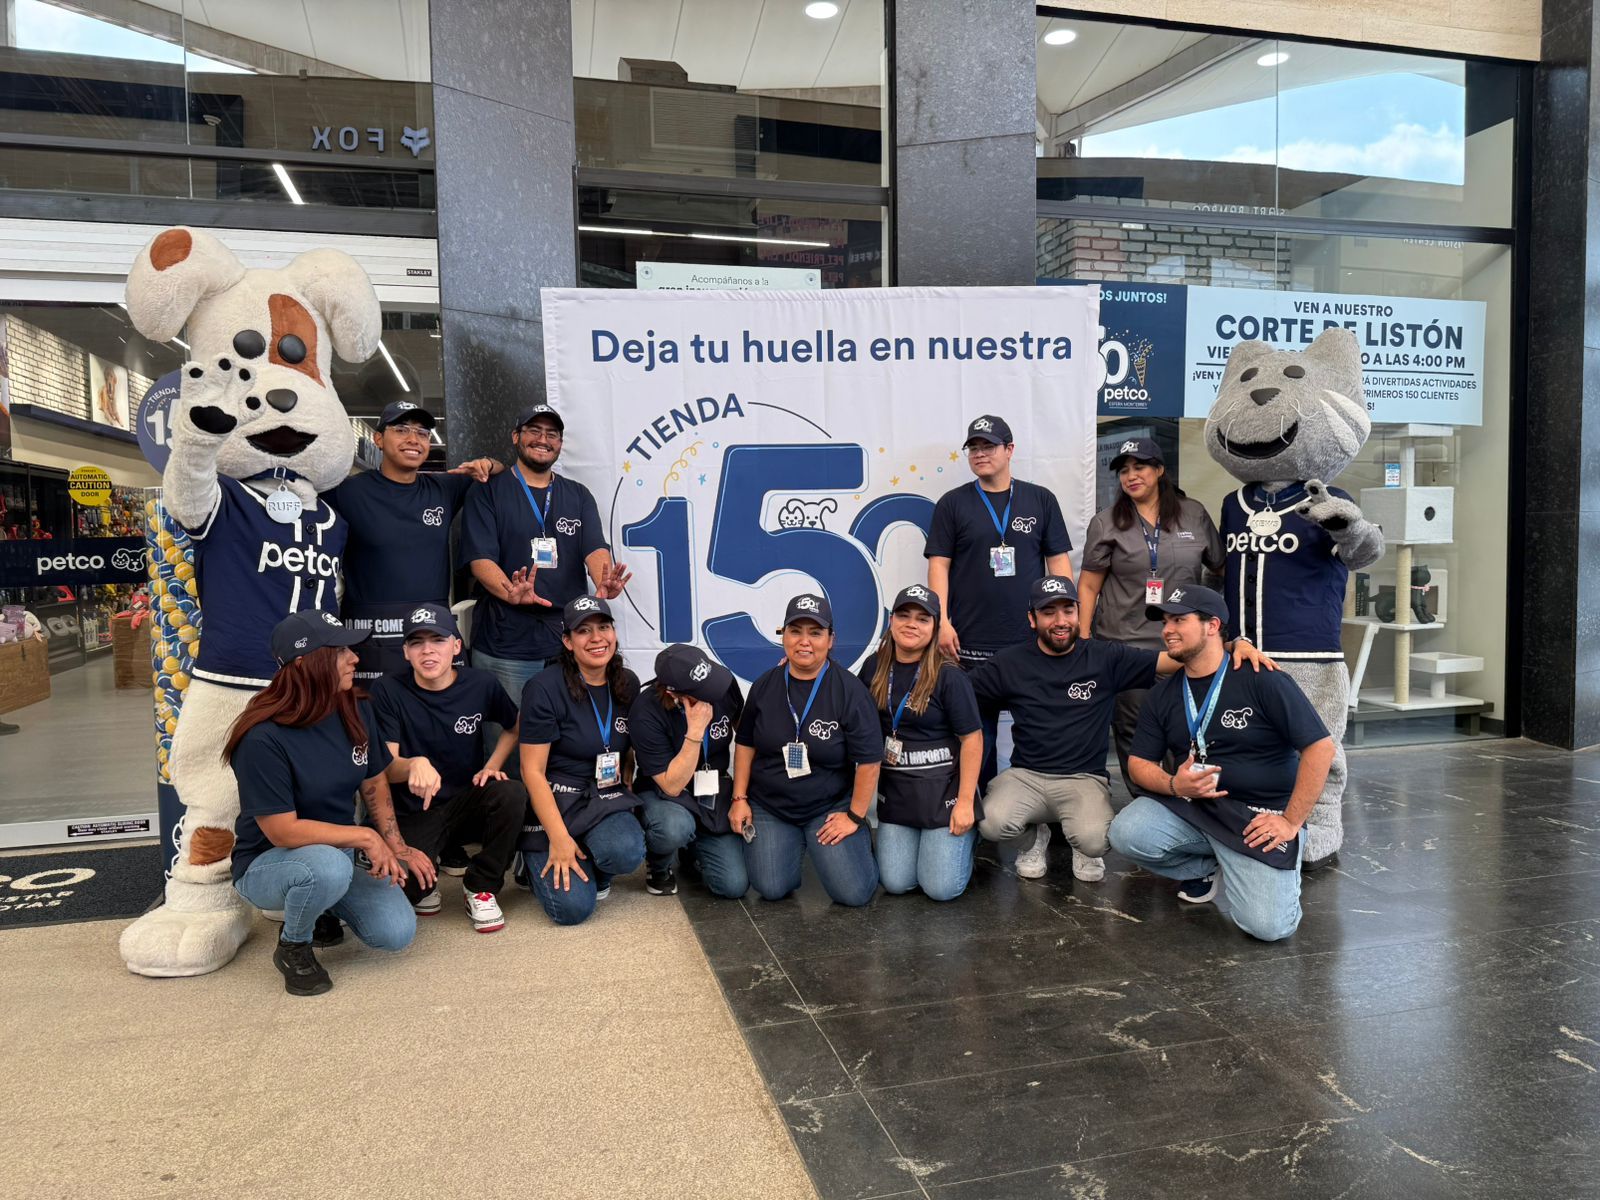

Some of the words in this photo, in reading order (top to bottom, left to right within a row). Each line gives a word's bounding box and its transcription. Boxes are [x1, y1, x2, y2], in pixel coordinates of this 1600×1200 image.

[691, 274, 752, 287] Acompáñanos
[1115, 291, 1167, 303] JUNTOS!
[1294, 301, 1319, 313] VEN
[1322, 302, 1331, 314] A
[1335, 304, 1393, 317] NUESTRO
[1215, 314, 1314, 343] CORTE
[1365, 319, 1463, 350] LISTÓN
[592, 329, 679, 371] Deja
[690, 334, 729, 363] tu
[743, 329, 857, 363] huella
[870, 337, 914, 361] en
[928, 331, 1072, 360] nuestra
[1373, 353, 1382, 365] A
[1385, 354, 1410, 366] LAS
[1413, 354, 1442, 367] 4:00
[1446, 356, 1465, 368] PM
[1192, 370, 1216, 381] ¡VEN
[1372, 377, 1421, 387] DIVERTIDAS
[1422, 379, 1477, 389] ACTIVIDADES
[148, 387, 177, 404] TIENDA
[1104, 386, 1148, 403] petco
[1362, 390, 1404, 399] PRIMEROS
[1405, 390, 1419, 399] 150
[1420, 391, 1459, 400] CLIENTES
[626, 393, 745, 461] TIENDA
[70, 481, 110, 489] CAUTION
[268, 501, 300, 511] RUFF
[1227, 532, 1299, 553] petco
[37, 553, 105, 575] petco
[258, 541, 339, 578] petco
[375, 619, 404, 633] COME
